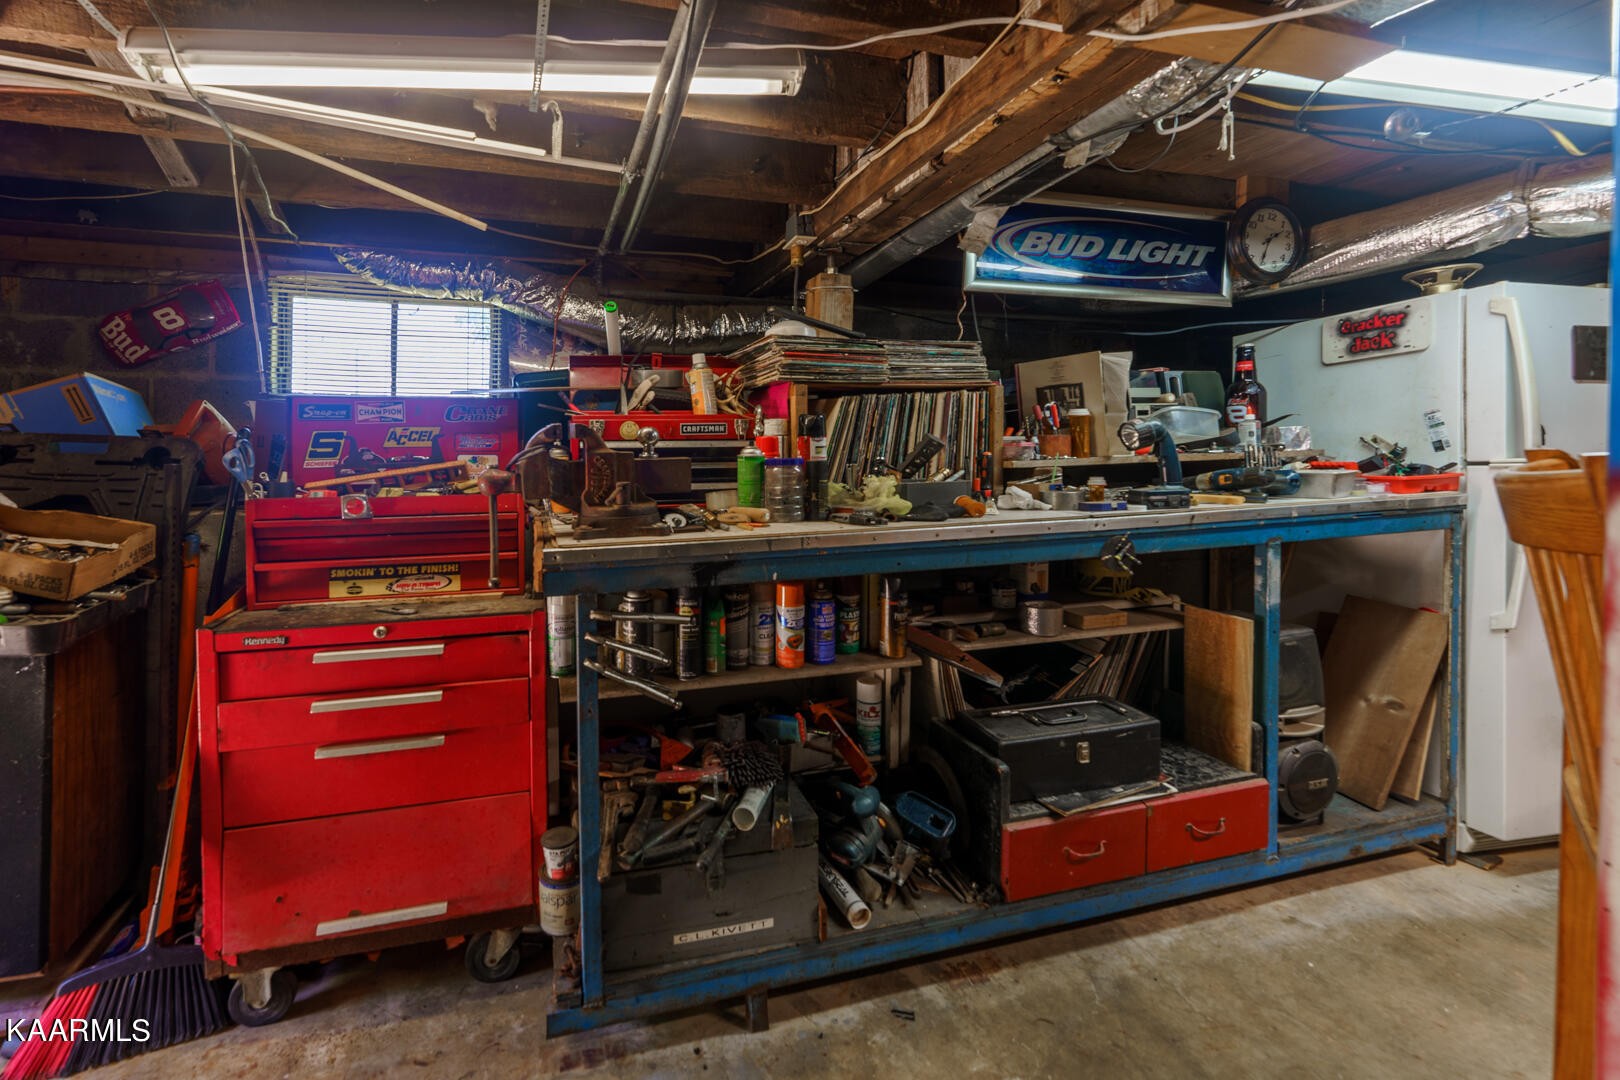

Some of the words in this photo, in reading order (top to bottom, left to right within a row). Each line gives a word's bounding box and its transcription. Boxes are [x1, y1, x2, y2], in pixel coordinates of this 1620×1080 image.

[1020, 231, 1105, 259] BUD
[1106, 238, 1216, 267] LIGHT
[152, 307, 185, 330] 8
[1341, 312, 1406, 335] Cracker
[101, 315, 150, 364] Bud
[1351, 331, 1396, 353] Jack
[303, 405, 347, 418] Snap-on
[359, 408, 402, 416] CHAMPION
[1226, 405, 1247, 423] 8
[682, 424, 725, 433] CRAFTSMAN
[331, 568, 376, 578] SMOKIN'
[379, 567, 394, 575] TO
[396, 565, 418, 574] THE
[421, 563, 459, 573] FINISH!
[244, 636, 285, 646] Kennedy
[540, 890, 577, 910] alspar
